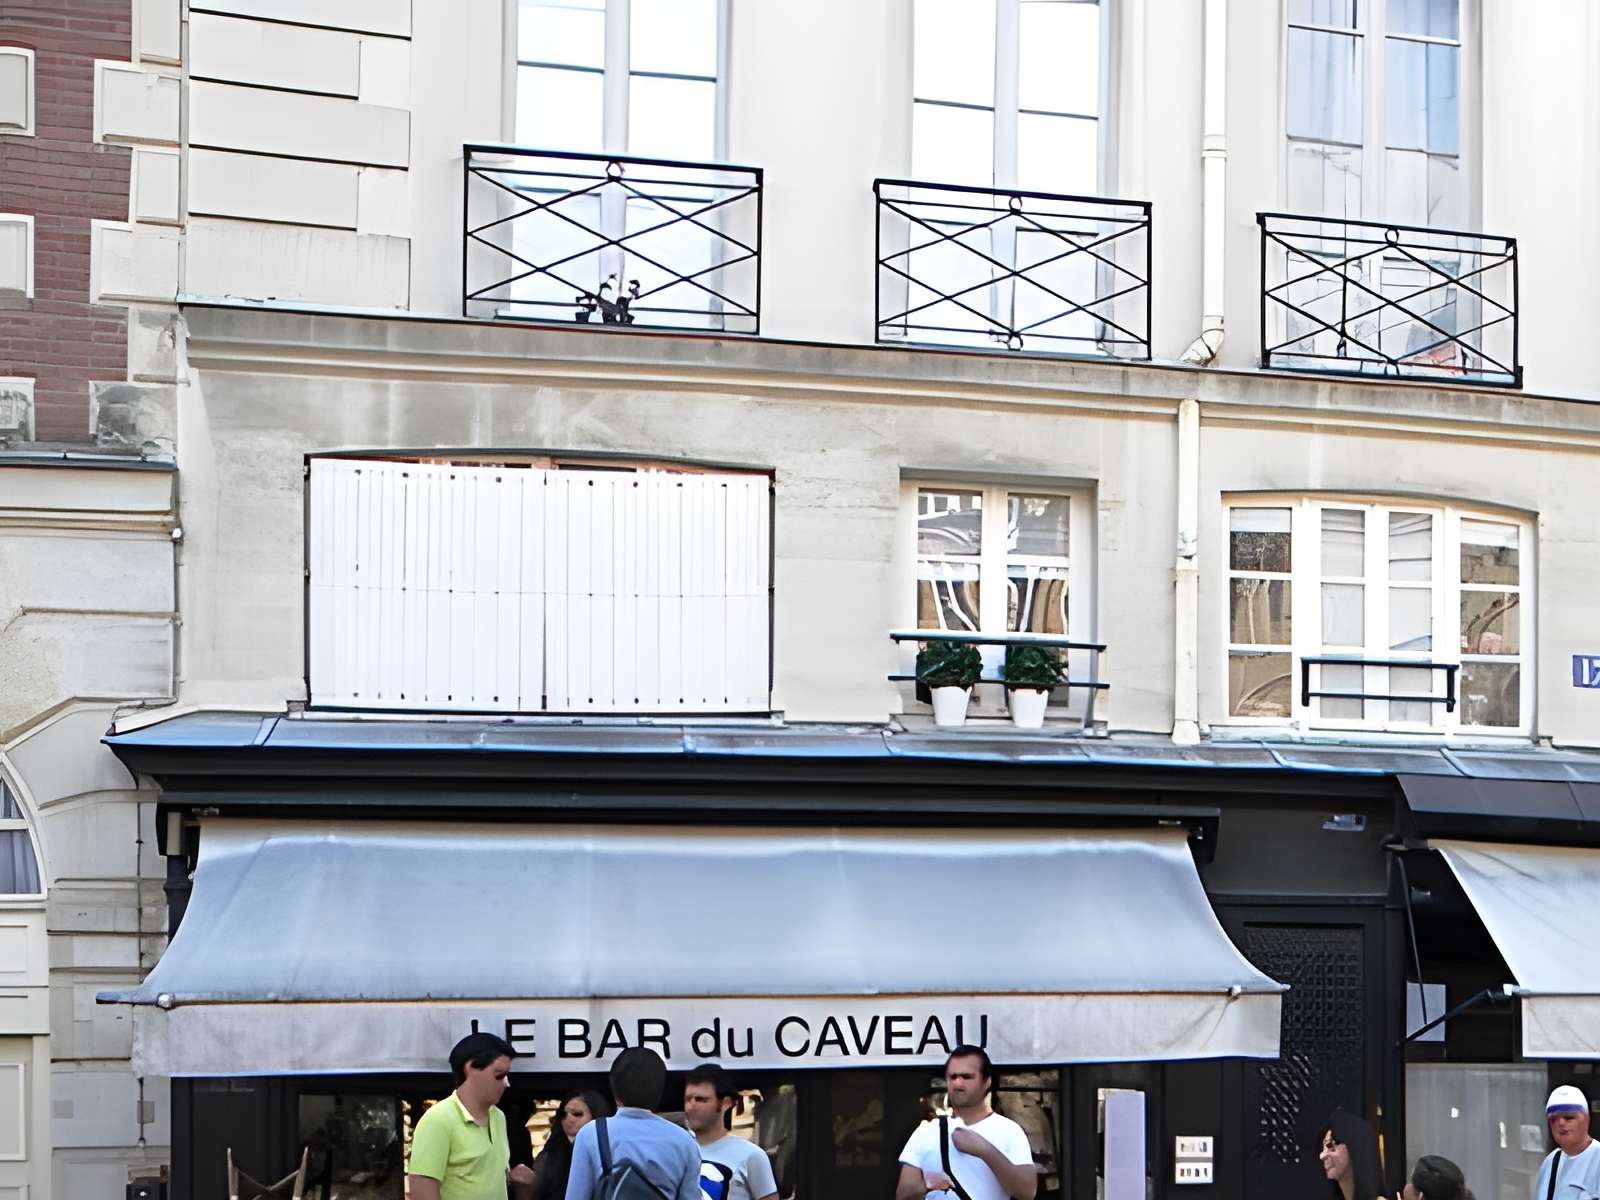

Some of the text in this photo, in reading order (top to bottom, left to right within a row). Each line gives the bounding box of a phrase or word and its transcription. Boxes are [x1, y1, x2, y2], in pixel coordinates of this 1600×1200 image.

[558, 1018, 671, 1059] BAR
[691, 1017, 754, 1058] du
[775, 1014, 988, 1057] CAVEAU
